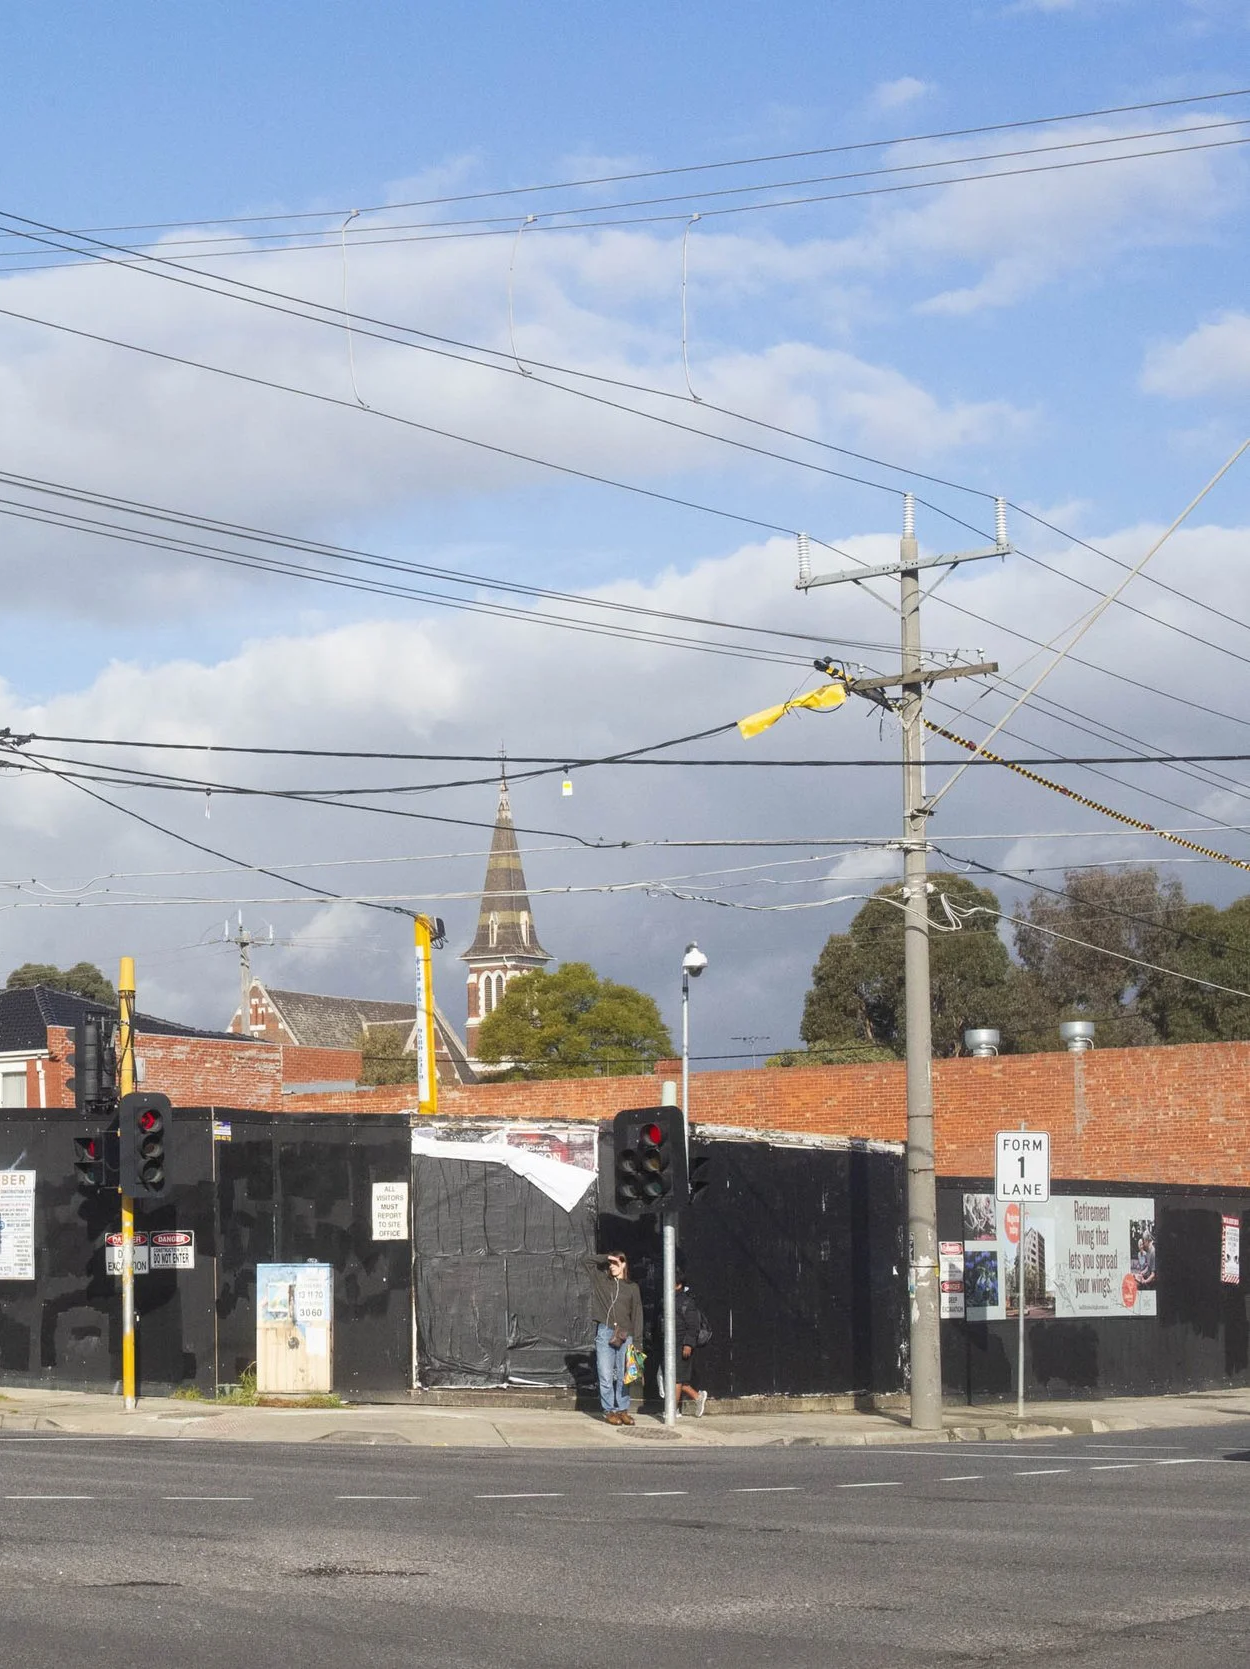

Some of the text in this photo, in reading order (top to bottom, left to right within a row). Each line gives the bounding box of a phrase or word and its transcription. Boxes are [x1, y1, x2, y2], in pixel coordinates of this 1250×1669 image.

[1003, 1139, 1042, 1151] FORM
[1017, 1156, 1025, 1178] 1
[384, 1185, 396, 1193] ALL
[1002, 1183, 1042, 1195] LANE
[376, 1194, 404, 1202] VISITORS
[381, 1203, 398, 1211] MUST
[1074, 1200, 1110, 1222] Retirement
[377, 1212, 402, 1220] REPORT
[379, 1221, 401, 1229] TO SITE
[1076, 1224, 1109, 1250] living that
[153, 1253, 189, 1264] DO NOT ENTER
[1068, 1248, 1118, 1274] lets you spread
[1075, 1274, 1112, 1298] your wings.
[300, 1308, 322, 1317] 3060
